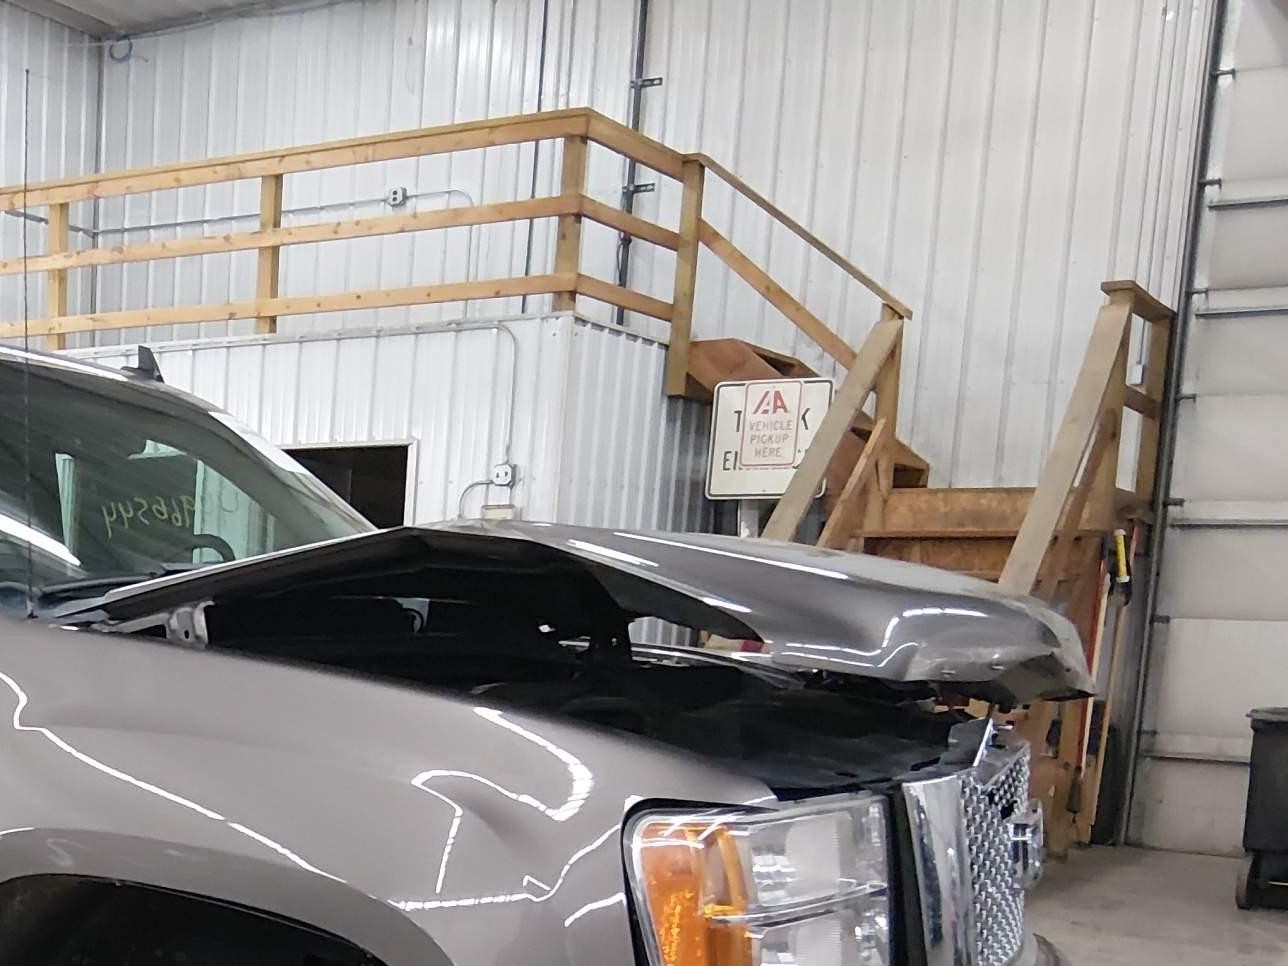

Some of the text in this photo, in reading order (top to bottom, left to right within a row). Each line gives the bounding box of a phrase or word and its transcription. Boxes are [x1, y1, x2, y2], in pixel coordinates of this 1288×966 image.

[749, 419, 793, 431] VEHICLE
[750, 433, 790, 445] PICKUP
[754, 447, 782, 458] HERE
